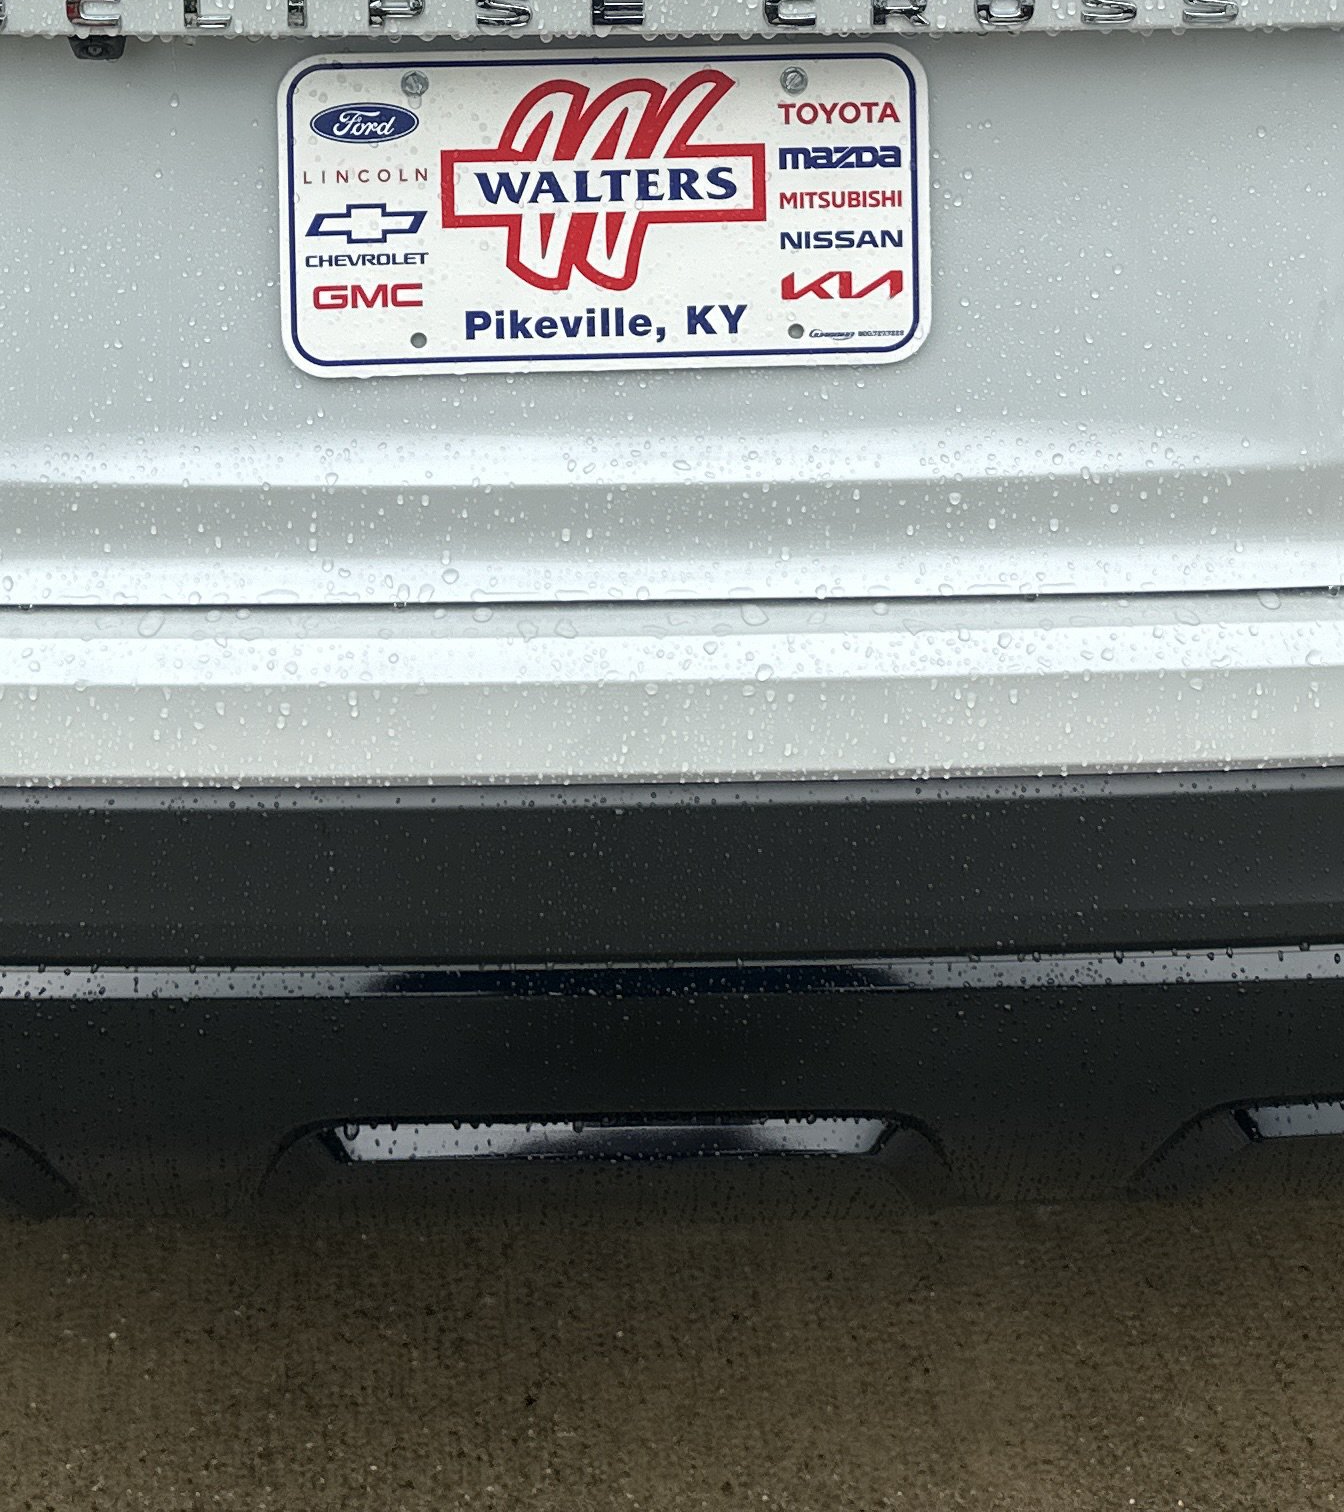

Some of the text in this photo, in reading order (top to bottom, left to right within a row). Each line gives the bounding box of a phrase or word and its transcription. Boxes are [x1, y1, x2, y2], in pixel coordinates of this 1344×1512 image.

[332, 110, 396, 136] Ford
[778, 102, 900, 125] TOYOTA
[303, 167, 428, 184] LINCOLN
[473, 166, 738, 206] WALTERS
[779, 190, 903, 210] MITSUBISHI
[780, 230, 904, 250] NISSAN
[305, 252, 426, 268] CHEVROLET
[313, 283, 424, 310] GMC
[780, 270, 903, 300] KIA
[465, 304, 748, 343] Pikeville, KY
